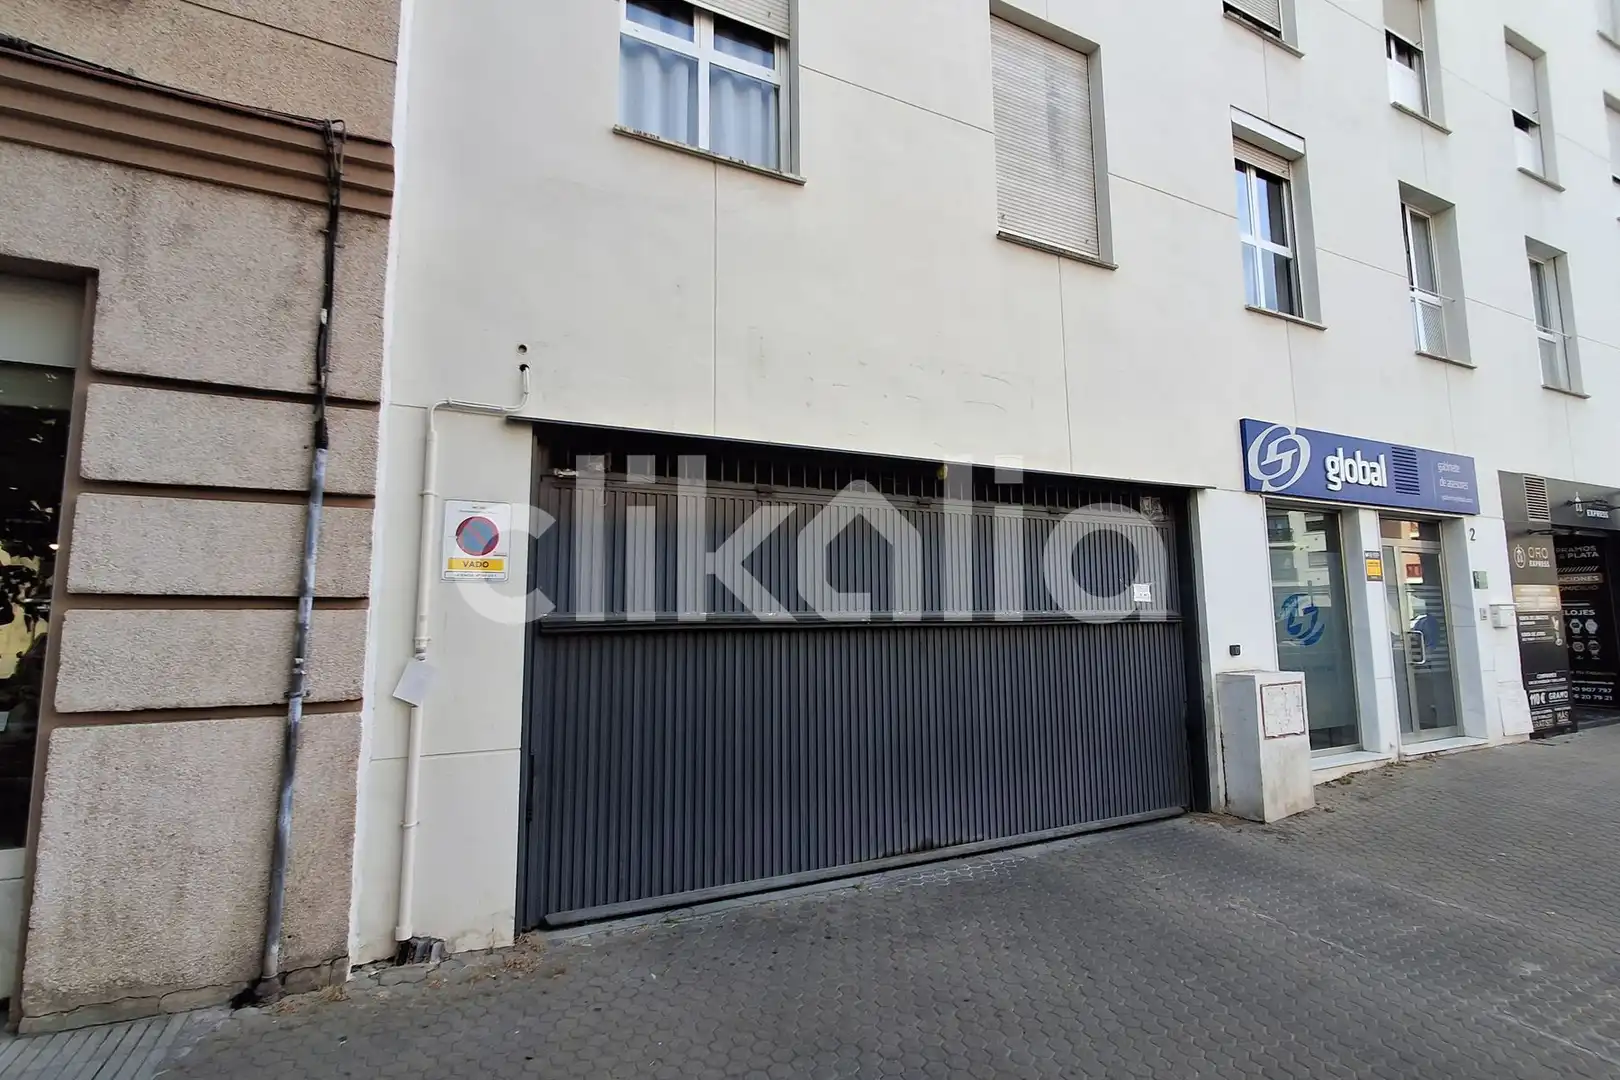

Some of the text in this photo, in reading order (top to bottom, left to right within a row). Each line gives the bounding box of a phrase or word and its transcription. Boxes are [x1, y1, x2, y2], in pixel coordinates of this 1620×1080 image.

[1325, 447, 1388, 491] global
[1469, 527, 1476, 541] 2
[1527, 546, 1549, 559] ORO
[1567, 551, 1600, 559] PLATA
[462, 560, 490, 569] VADO
